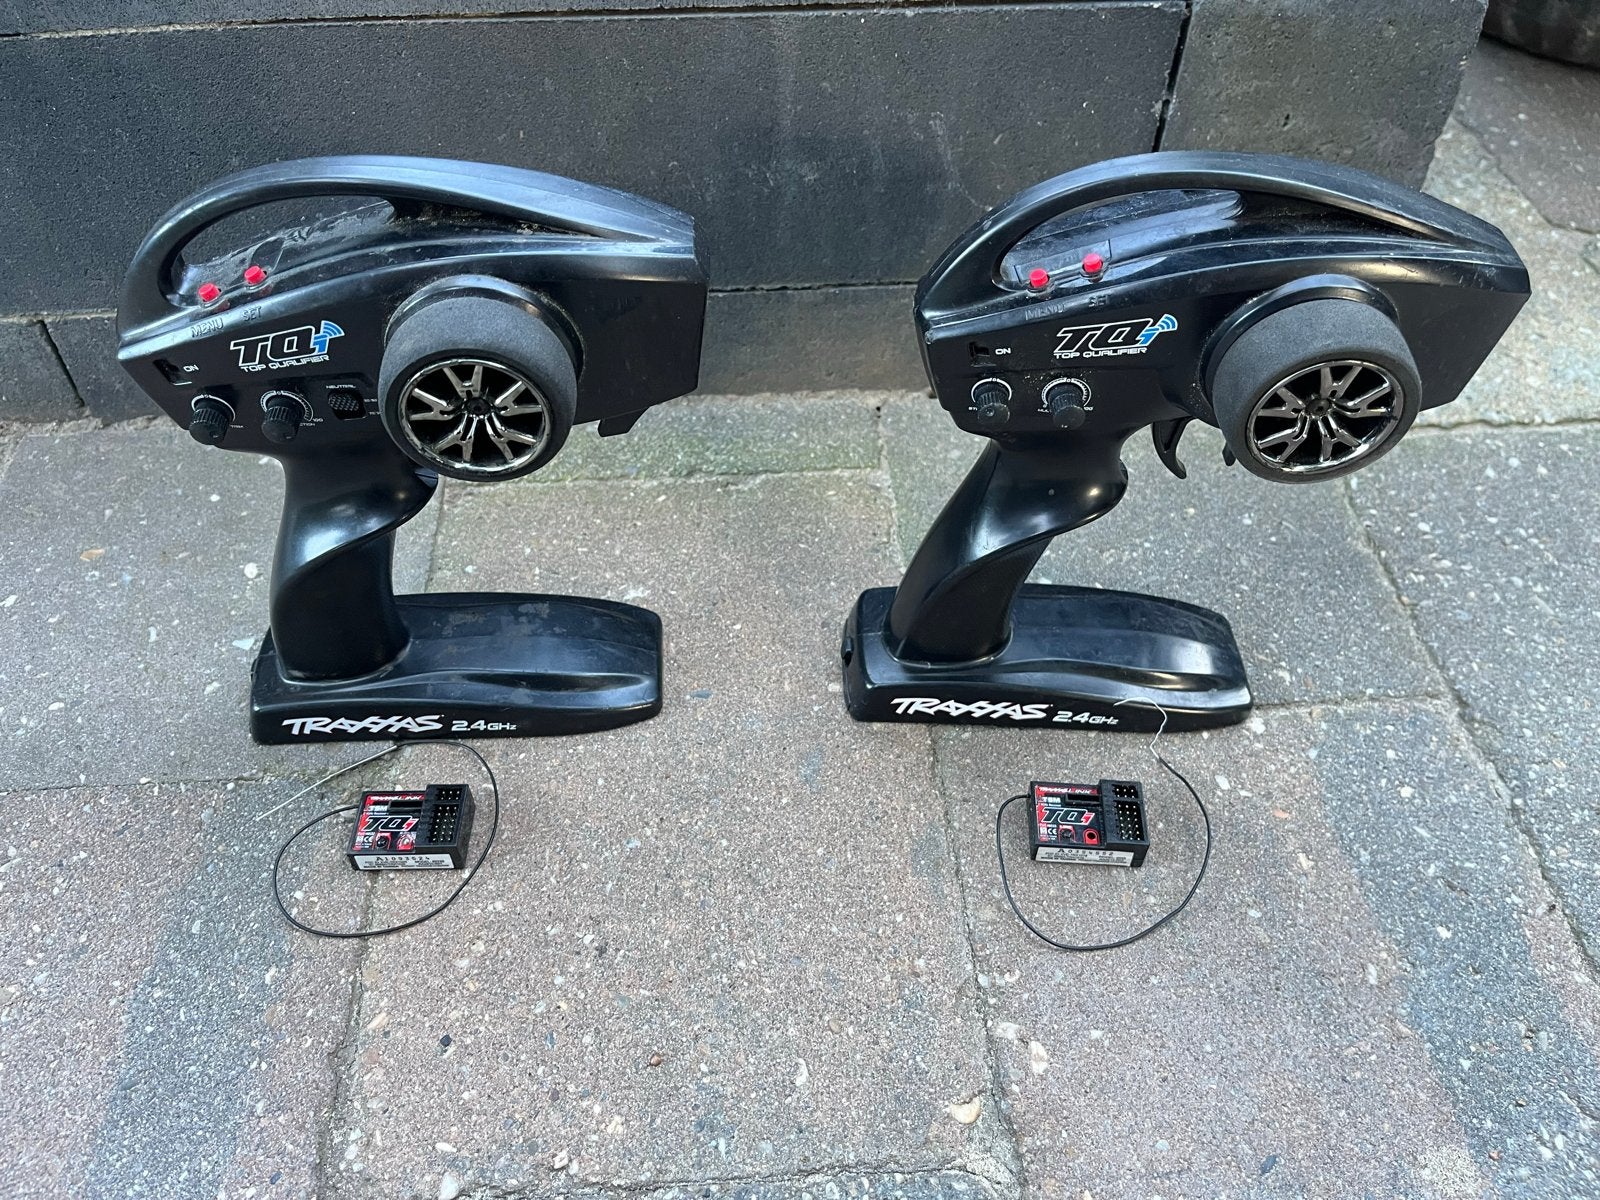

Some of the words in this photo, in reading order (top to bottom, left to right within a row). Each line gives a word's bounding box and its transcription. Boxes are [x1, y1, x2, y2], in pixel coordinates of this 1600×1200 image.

[242, 306, 263, 322] SET
[190, 317, 224, 339] MENU
[994, 347, 1012, 356] ON
[1053, 351, 1081, 360] TOP
[1082, 346, 1148, 359] QUALIFIER
[183, 363, 200, 373] ON
[240, 363, 267, 373] TOP
[268, 354, 331, 371] QUALIFIER
[889, 697, 1053, 721] TRAXXAS
[1052, 710, 1119, 725] 2.4GHz
[282, 714, 445, 736] TRAXXAS
[451, 719, 517, 732] 2.4GHz
